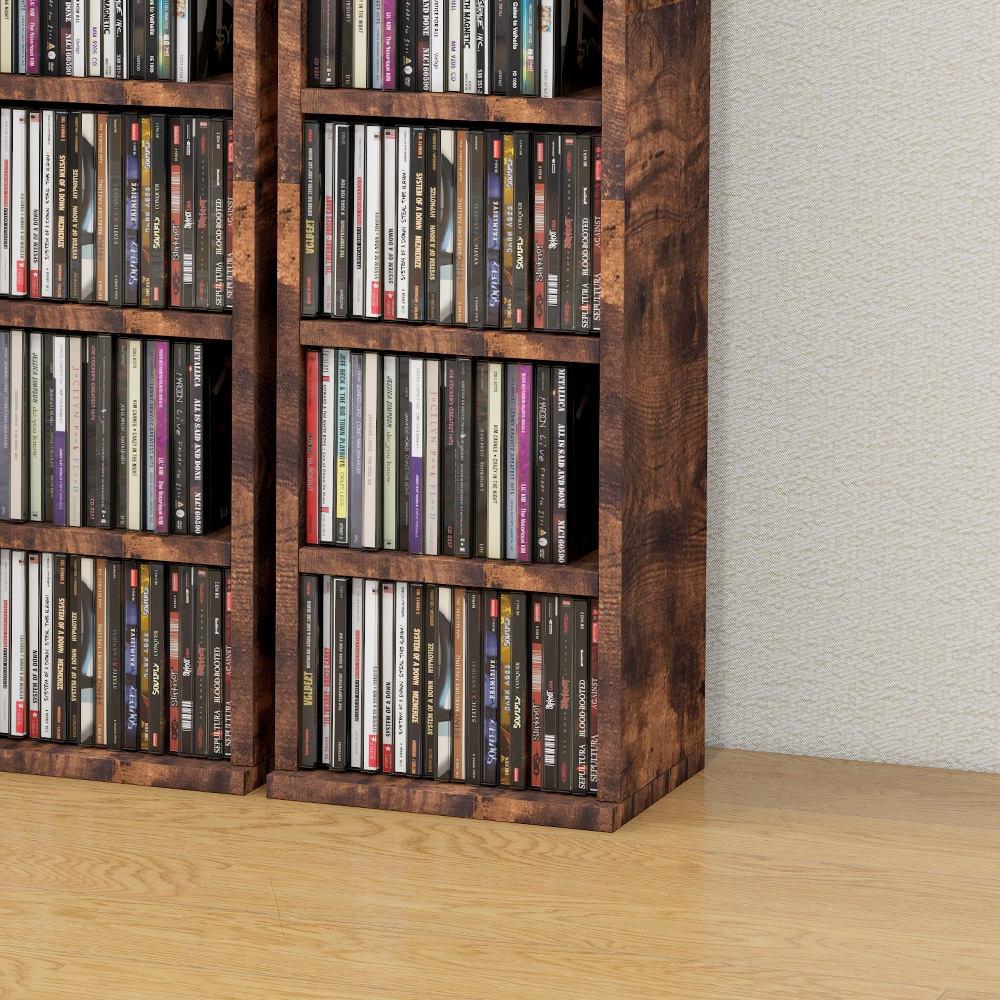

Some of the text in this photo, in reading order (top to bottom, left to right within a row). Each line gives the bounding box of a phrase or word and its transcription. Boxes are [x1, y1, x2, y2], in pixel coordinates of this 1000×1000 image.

[451, 41, 456, 51] MM
[451, 72, 456, 81] CD
[33, 232, 38, 240] OF
[32, 407, 37, 417] do
